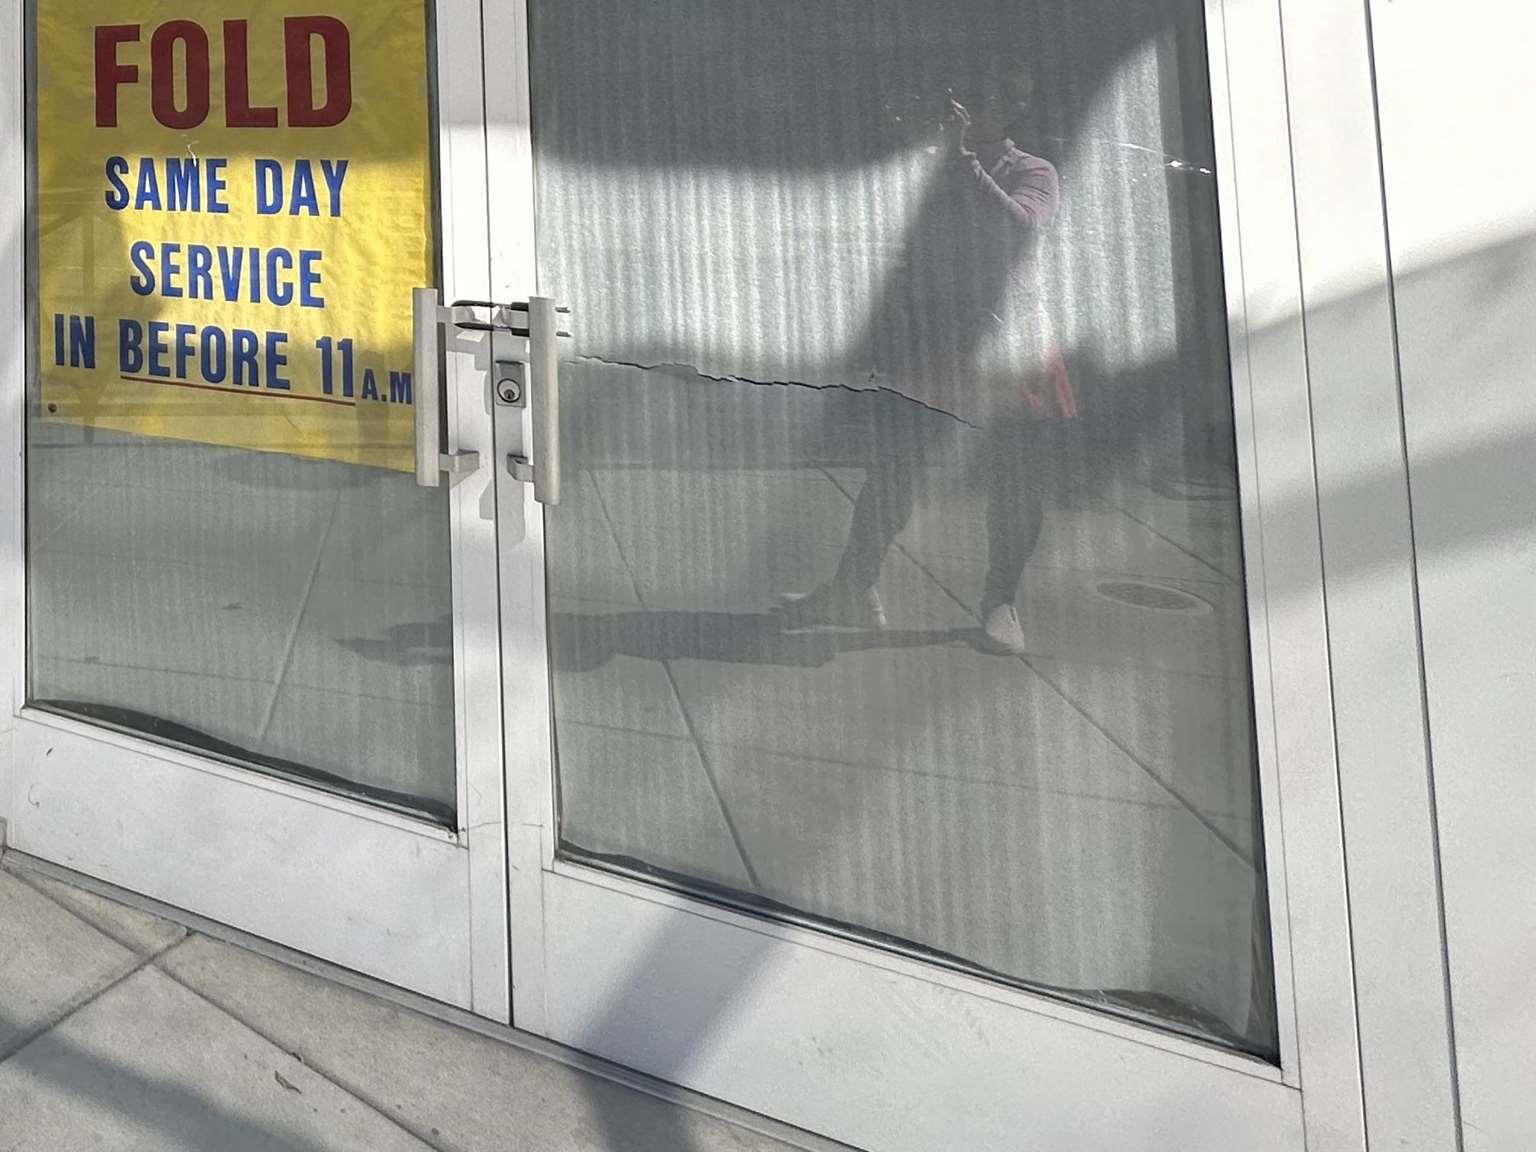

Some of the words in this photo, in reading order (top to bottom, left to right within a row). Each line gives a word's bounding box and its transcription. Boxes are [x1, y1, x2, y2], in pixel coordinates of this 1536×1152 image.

[93, 15, 353, 130] FOLD
[105, 156, 229, 214] SAME
[256, 159, 349, 218] DAY
[130, 240, 325, 309] SERVICE
[54, 313, 95, 369] IN
[119, 318, 291, 391] BEFORE
[316, 335, 354, 398] 11
